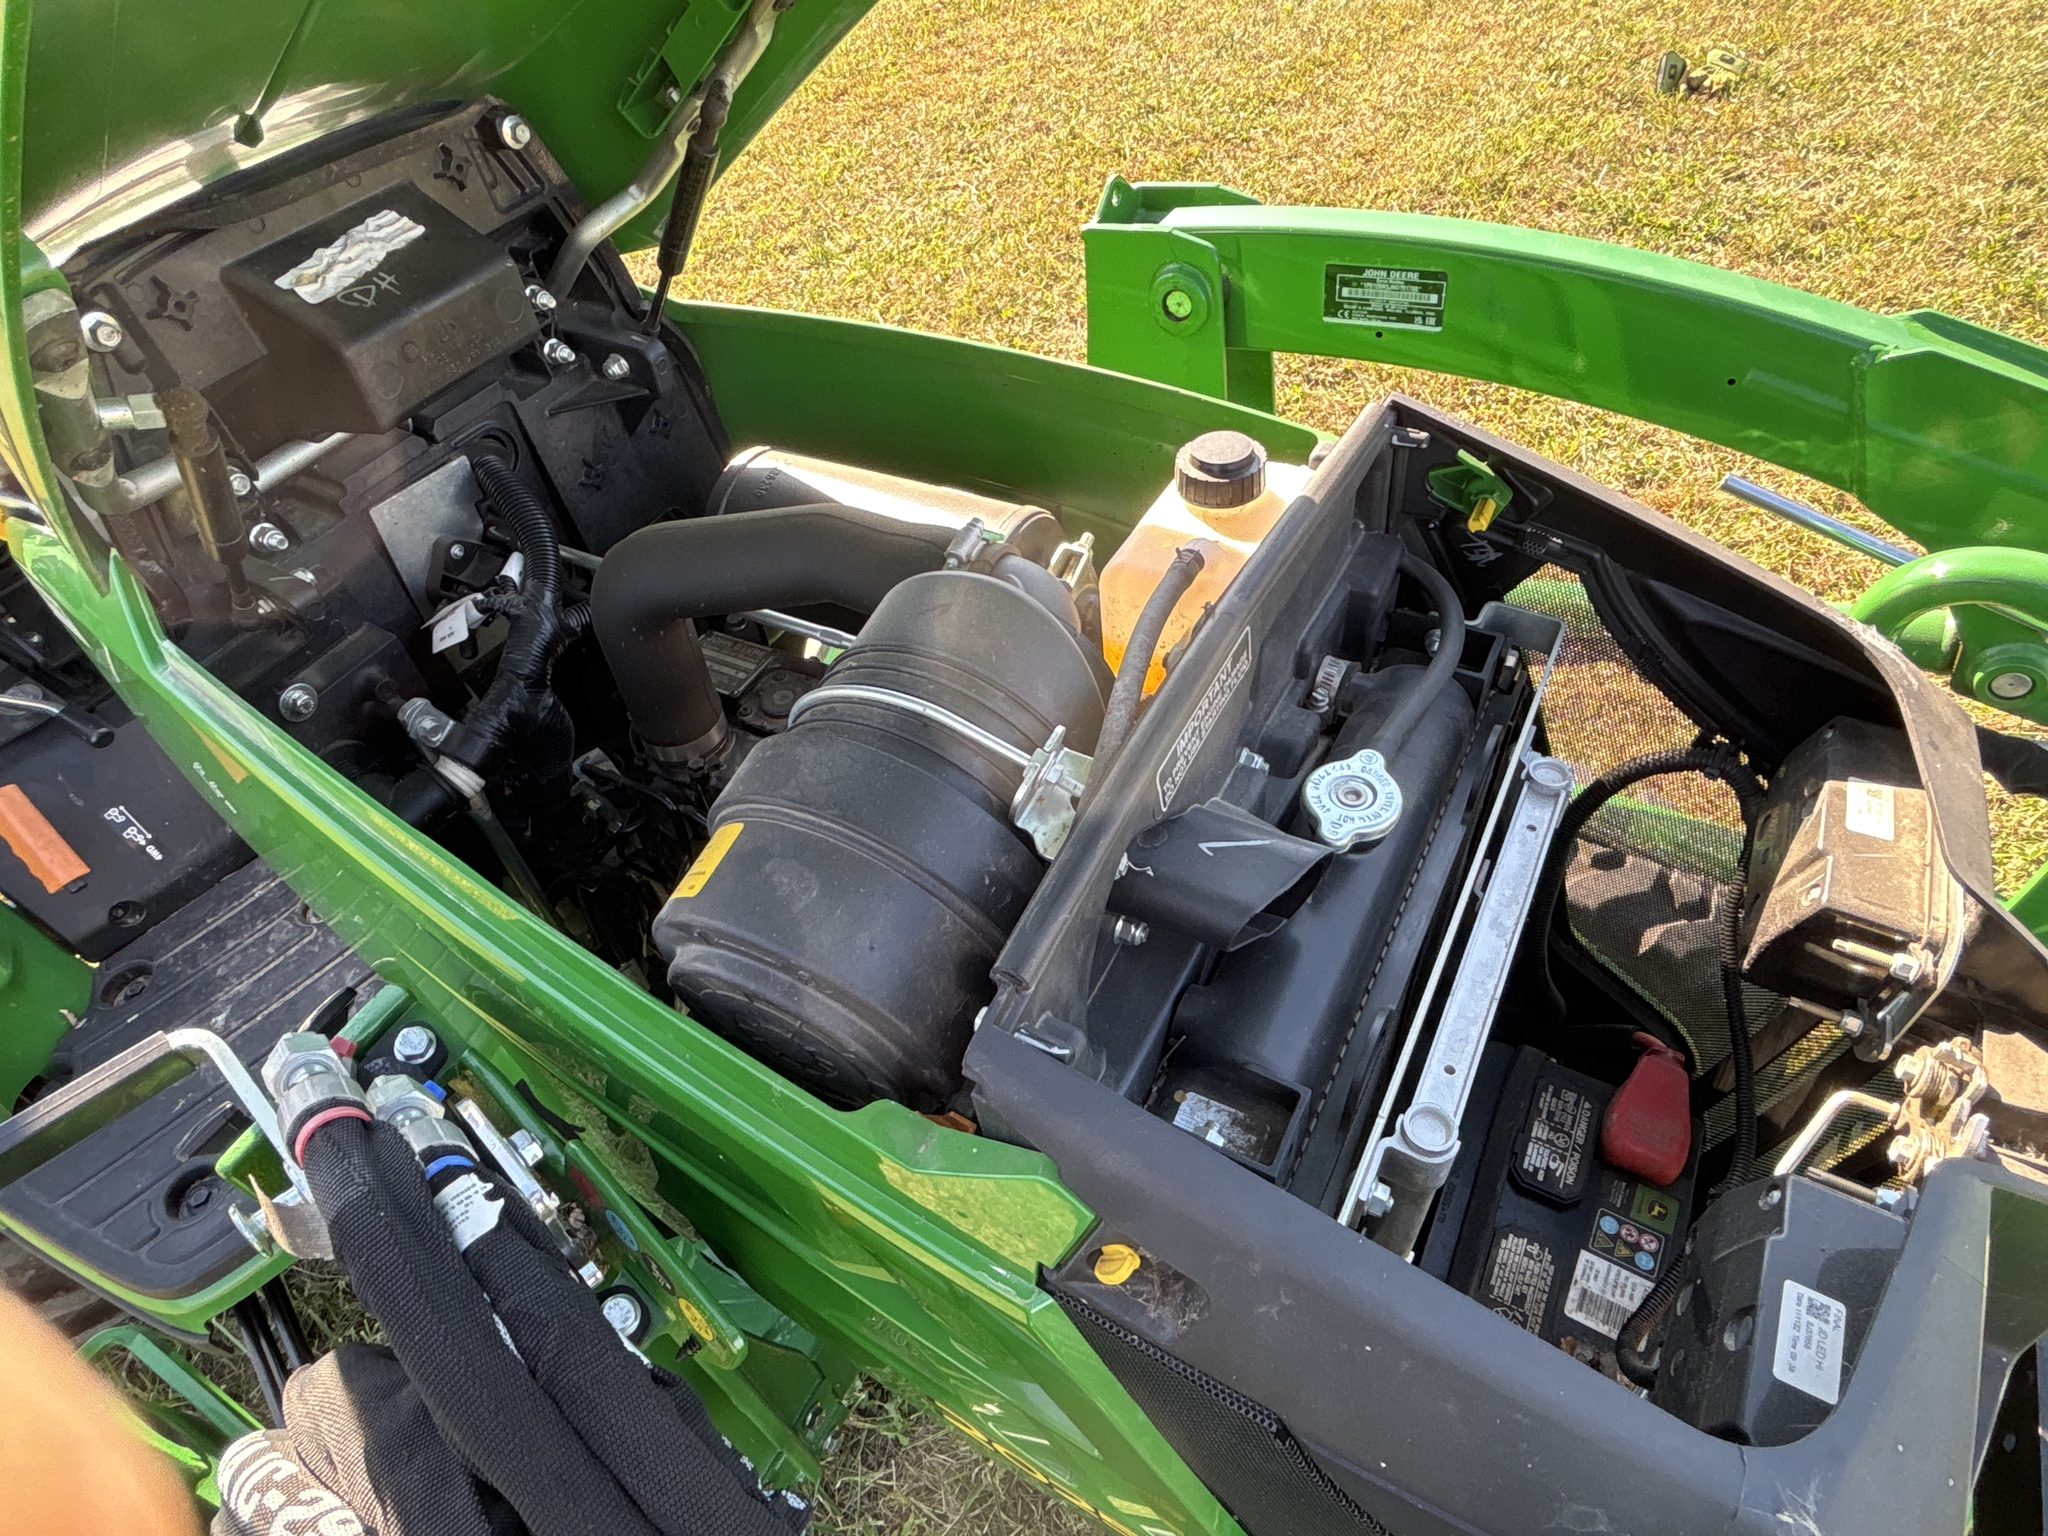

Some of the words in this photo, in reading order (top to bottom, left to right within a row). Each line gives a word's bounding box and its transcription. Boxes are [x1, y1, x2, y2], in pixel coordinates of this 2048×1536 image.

[1362, 268, 1387, 277] JOHN
[1389, 270, 1419, 280] DEERE
[707, 634, 734, 648] JOHN
[1176, 656, 1233, 757] IMPORTANT
[1172, 727, 1201, 777] PREVENT
[1200, 690, 1223, 729] ENGINE
[1174, 759, 1188, 784] NOT
[1187, 736, 1201, 760] USE
[145, 842, 163, 862] 4WD
[1575, 1110, 1591, 1145] DANGER
[1565, 1151, 1581, 1185] POISON
[1795, 1292, 1804, 1307] Date
[1832, 1308, 1844, 1333] FINAL
[1790, 1335, 1799, 1350] Time
[1818, 1327, 1828, 1340] JD
[1816, 1340, 1827, 1360] LED
[1815, 1360, 1824, 1371] HI
